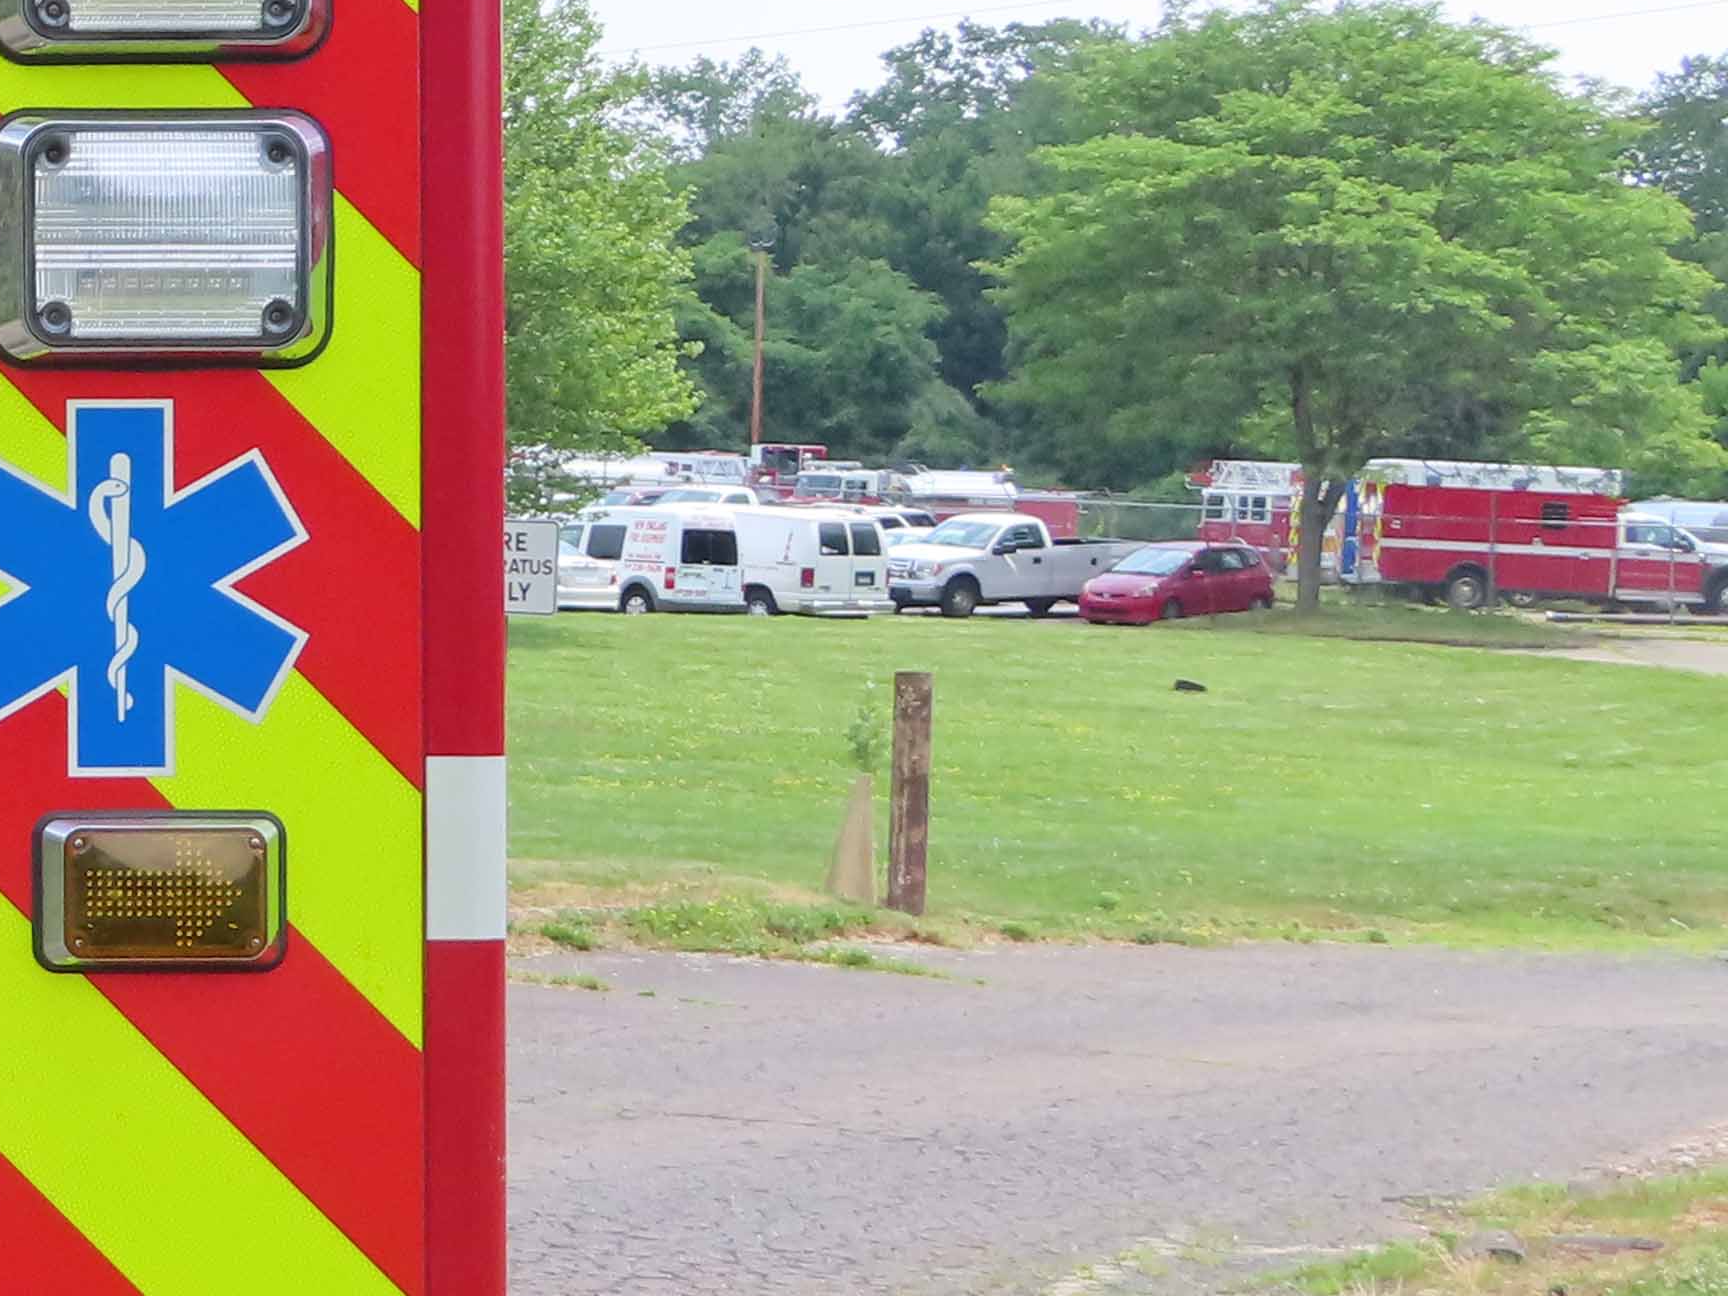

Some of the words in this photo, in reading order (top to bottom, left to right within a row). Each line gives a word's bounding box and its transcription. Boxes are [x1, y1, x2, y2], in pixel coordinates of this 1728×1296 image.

[503, 532, 528, 552] RE
[504, 557, 553, 575] ATUS
[508, 582, 531, 601] LY
